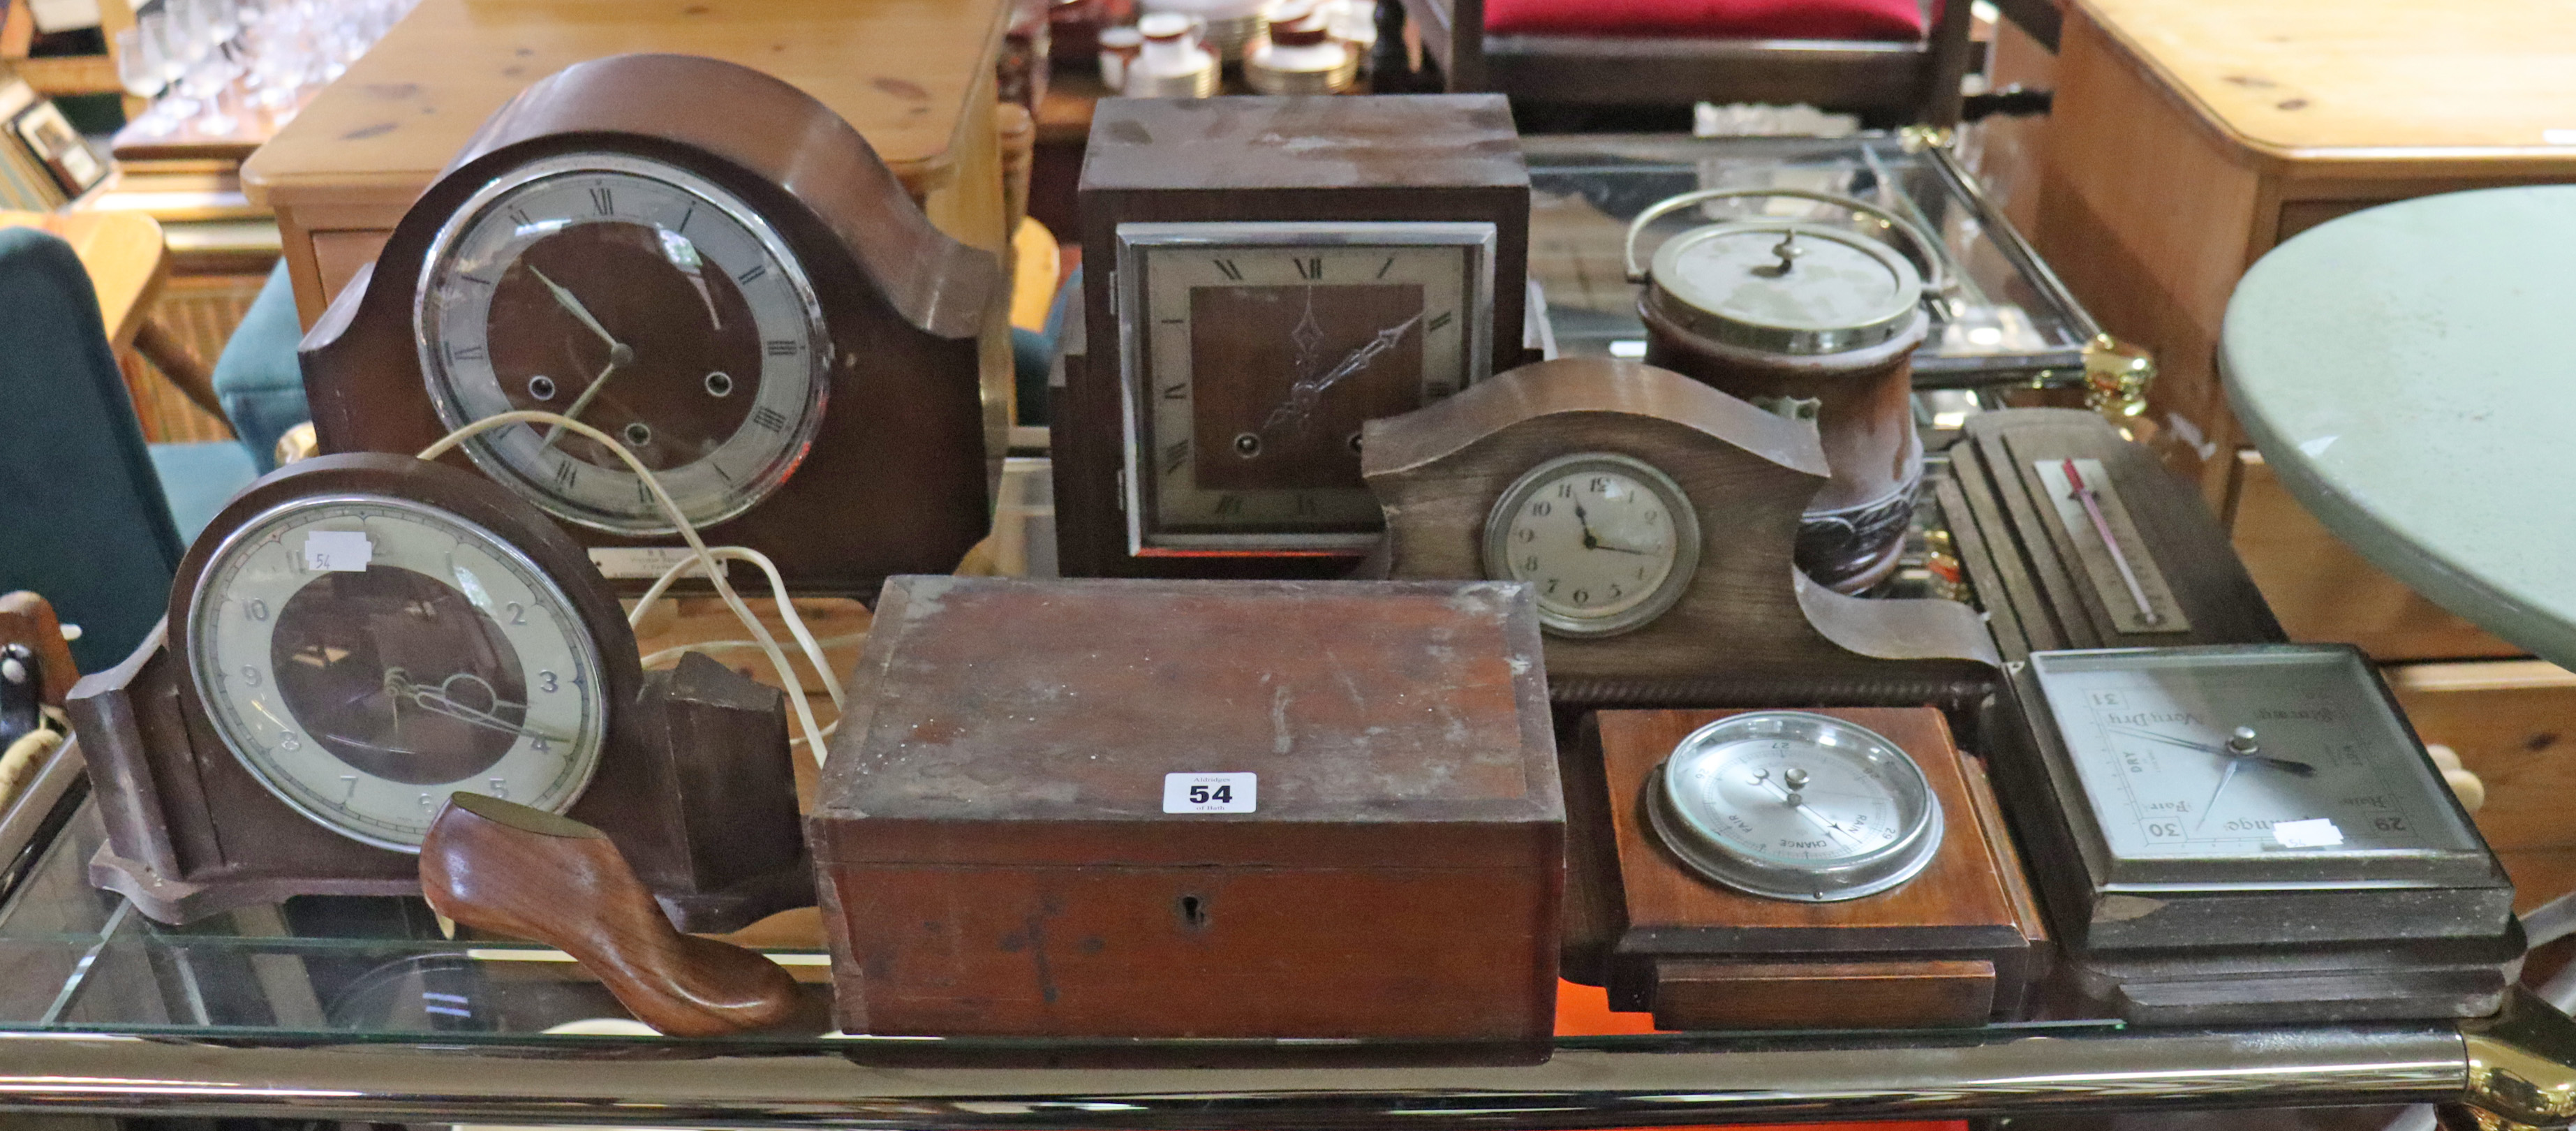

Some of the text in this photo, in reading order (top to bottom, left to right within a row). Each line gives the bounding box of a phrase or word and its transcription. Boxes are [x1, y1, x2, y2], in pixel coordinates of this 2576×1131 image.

[767, 339, 797, 356] III
[1558, 484, 1571, 498] 11
[1533, 501, 1551, 517] 10
[1518, 528, 1534, 543] 9
[286, 549, 306, 574] 11
[316, 554, 331, 570] 54
[1525, 556, 1538, 571] 8
[1548, 578, 1560, 593] 7
[1610, 582, 1622, 599] 5
[240, 597, 269, 621] 10
[506, 601, 526, 626] 2
[242, 664, 262, 688] 9
[538, 670, 559, 693] 3
[2092, 693, 2119, 706] 31
[2108, 712, 2203, 726] Very Dry
[279, 731, 302, 752] 8
[530, 732, 552, 753] 4
[2123, 751, 2142, 773] DRY
[1695, 768, 1710, 779] 26
[340, 776, 359, 799] 7
[489, 778, 510, 799] 5
[1190, 785, 1233, 804] 54
[2150, 801, 2189, 812] Fair
[1729, 815, 1753, 833] FAIR
[1848, 813, 1867, 834] RAIN
[2149, 822, 2180, 837] 30
[2375, 817, 2406, 831] 29
[1882, 827, 1896, 839] 29
[1778, 839, 1828, 849] CHANGE
